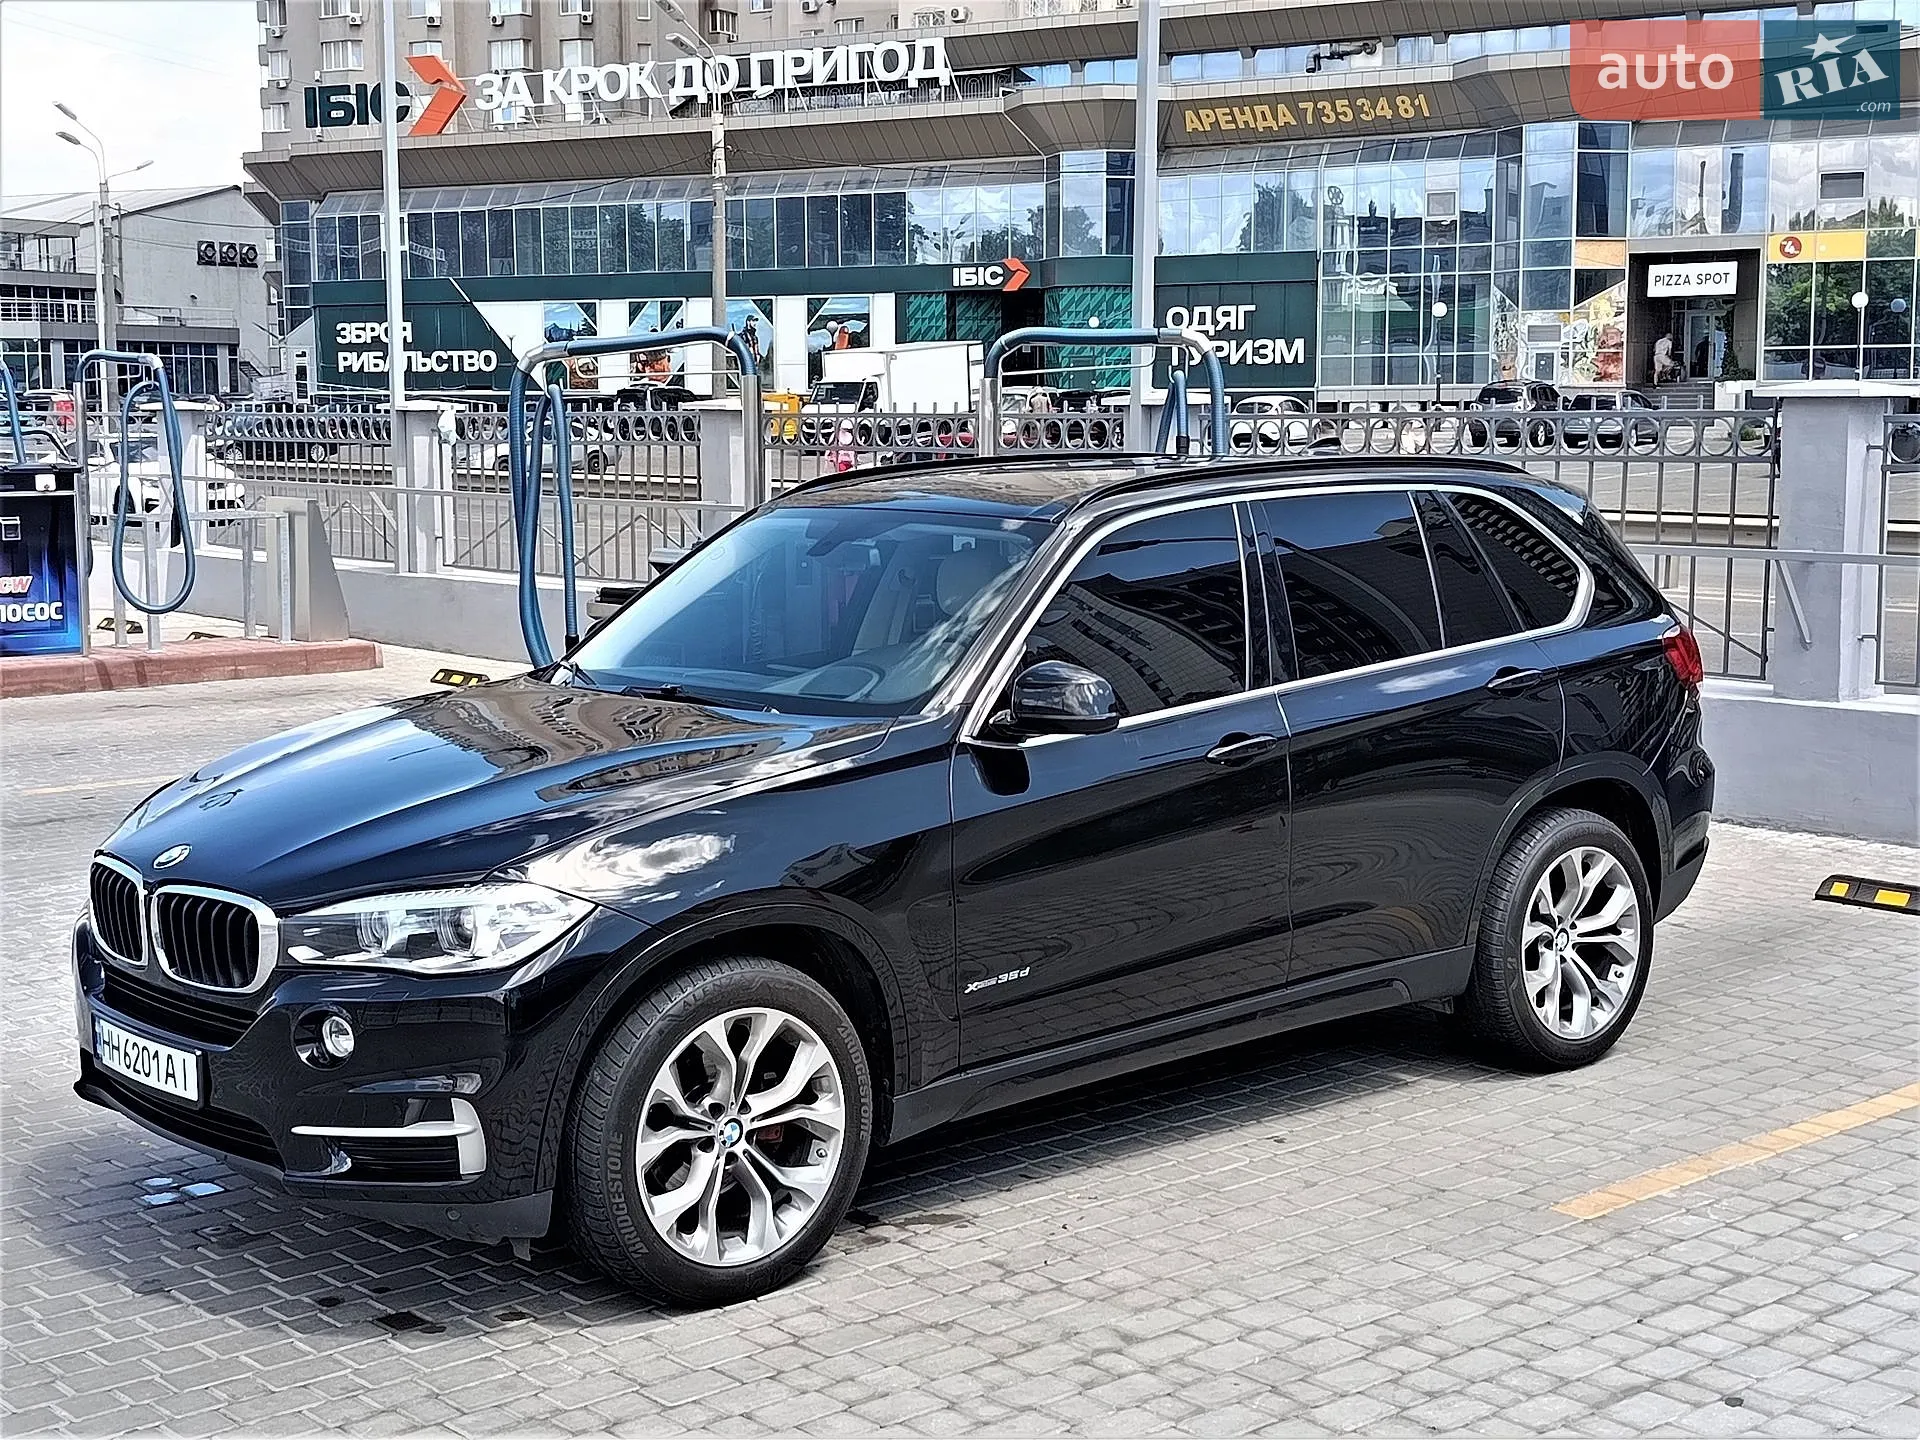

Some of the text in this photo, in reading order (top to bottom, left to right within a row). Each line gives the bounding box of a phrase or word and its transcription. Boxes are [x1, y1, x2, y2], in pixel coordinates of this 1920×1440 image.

[474, 37, 951, 111] ЗА КРОК ДО ПРИГОД
[304, 81, 411, 128] ІБІС
[1184, 94, 1431, 132] АРЕНДА 735 34 81
[952, 265, 1004, 287] ІБІС
[1654, 272, 1730, 286] PIZZA SPOT
[1165, 304, 1257, 336] ОДЯГ
[337, 350, 498, 373] РИБЛЬСТВО
